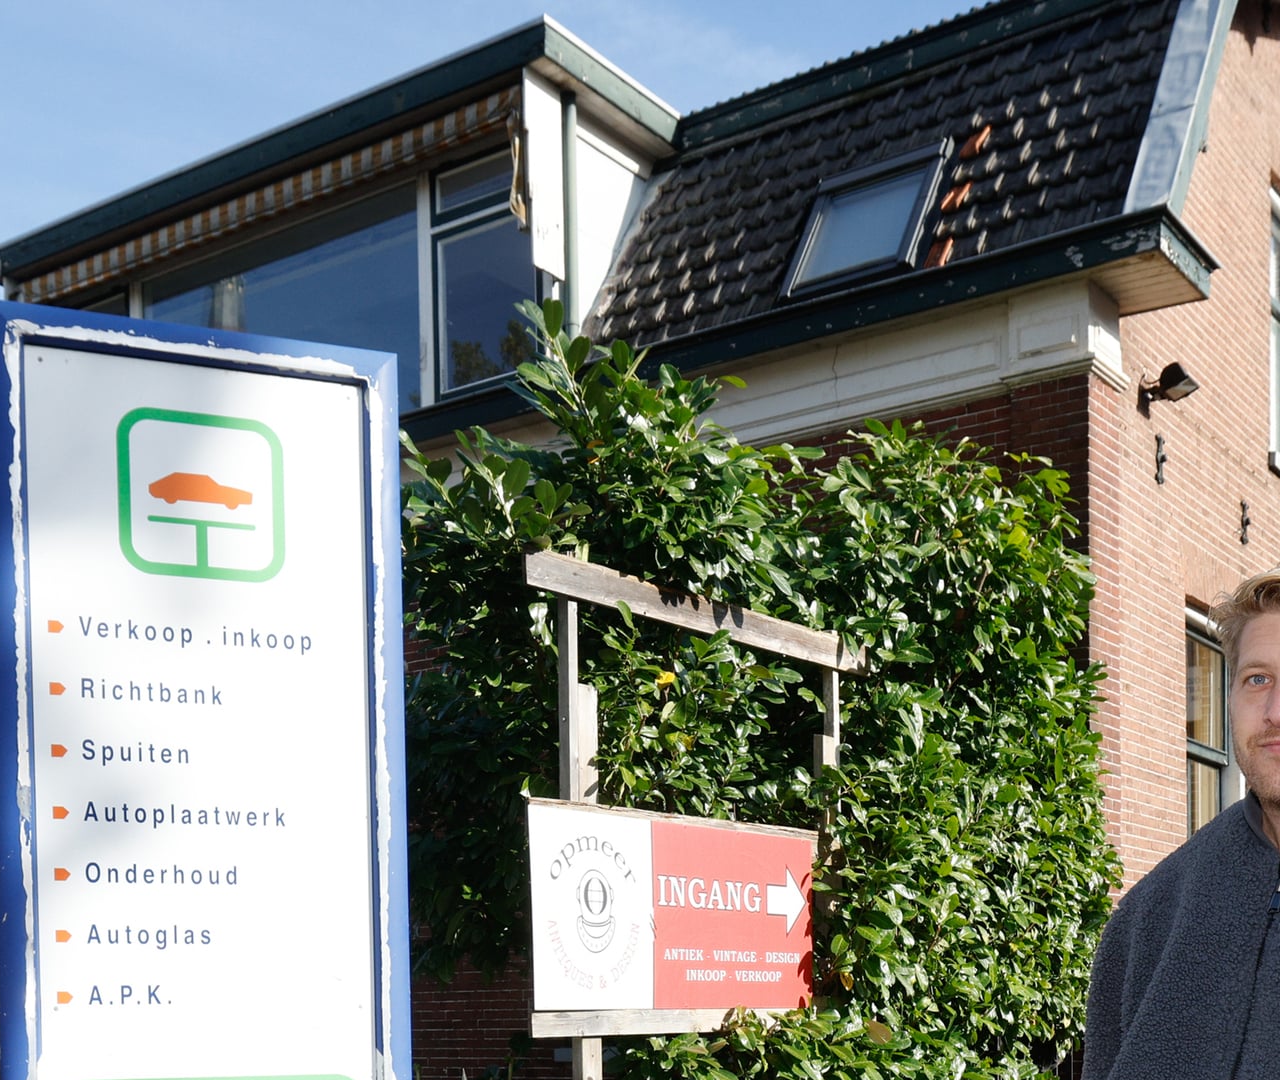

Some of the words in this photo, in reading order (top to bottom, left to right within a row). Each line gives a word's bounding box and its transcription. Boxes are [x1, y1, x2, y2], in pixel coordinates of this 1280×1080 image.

[79, 616, 193, 648] Verkoop
[222, 626, 313, 656] inkoop
[81, 678, 222, 706] Richtbank
[81, 740, 190, 767] Spuiten
[83, 801, 286, 828] Autoplaatwerk
[550, 835, 636, 883] opmeer
[85, 861, 238, 885] Onderhoud
[657, 874, 762, 913] INGANG
[87, 924, 212, 950] Autoglas
[664, 948, 704, 961] ANTIEK
[713, 950, 757, 962] VINTAGE
[766, 952, 801, 963] DESIGN
[686, 969, 726, 981] INKOOP
[735, 970, 782, 982] VERKOOP
[89, 985, 172, 1005] A.P.K.
